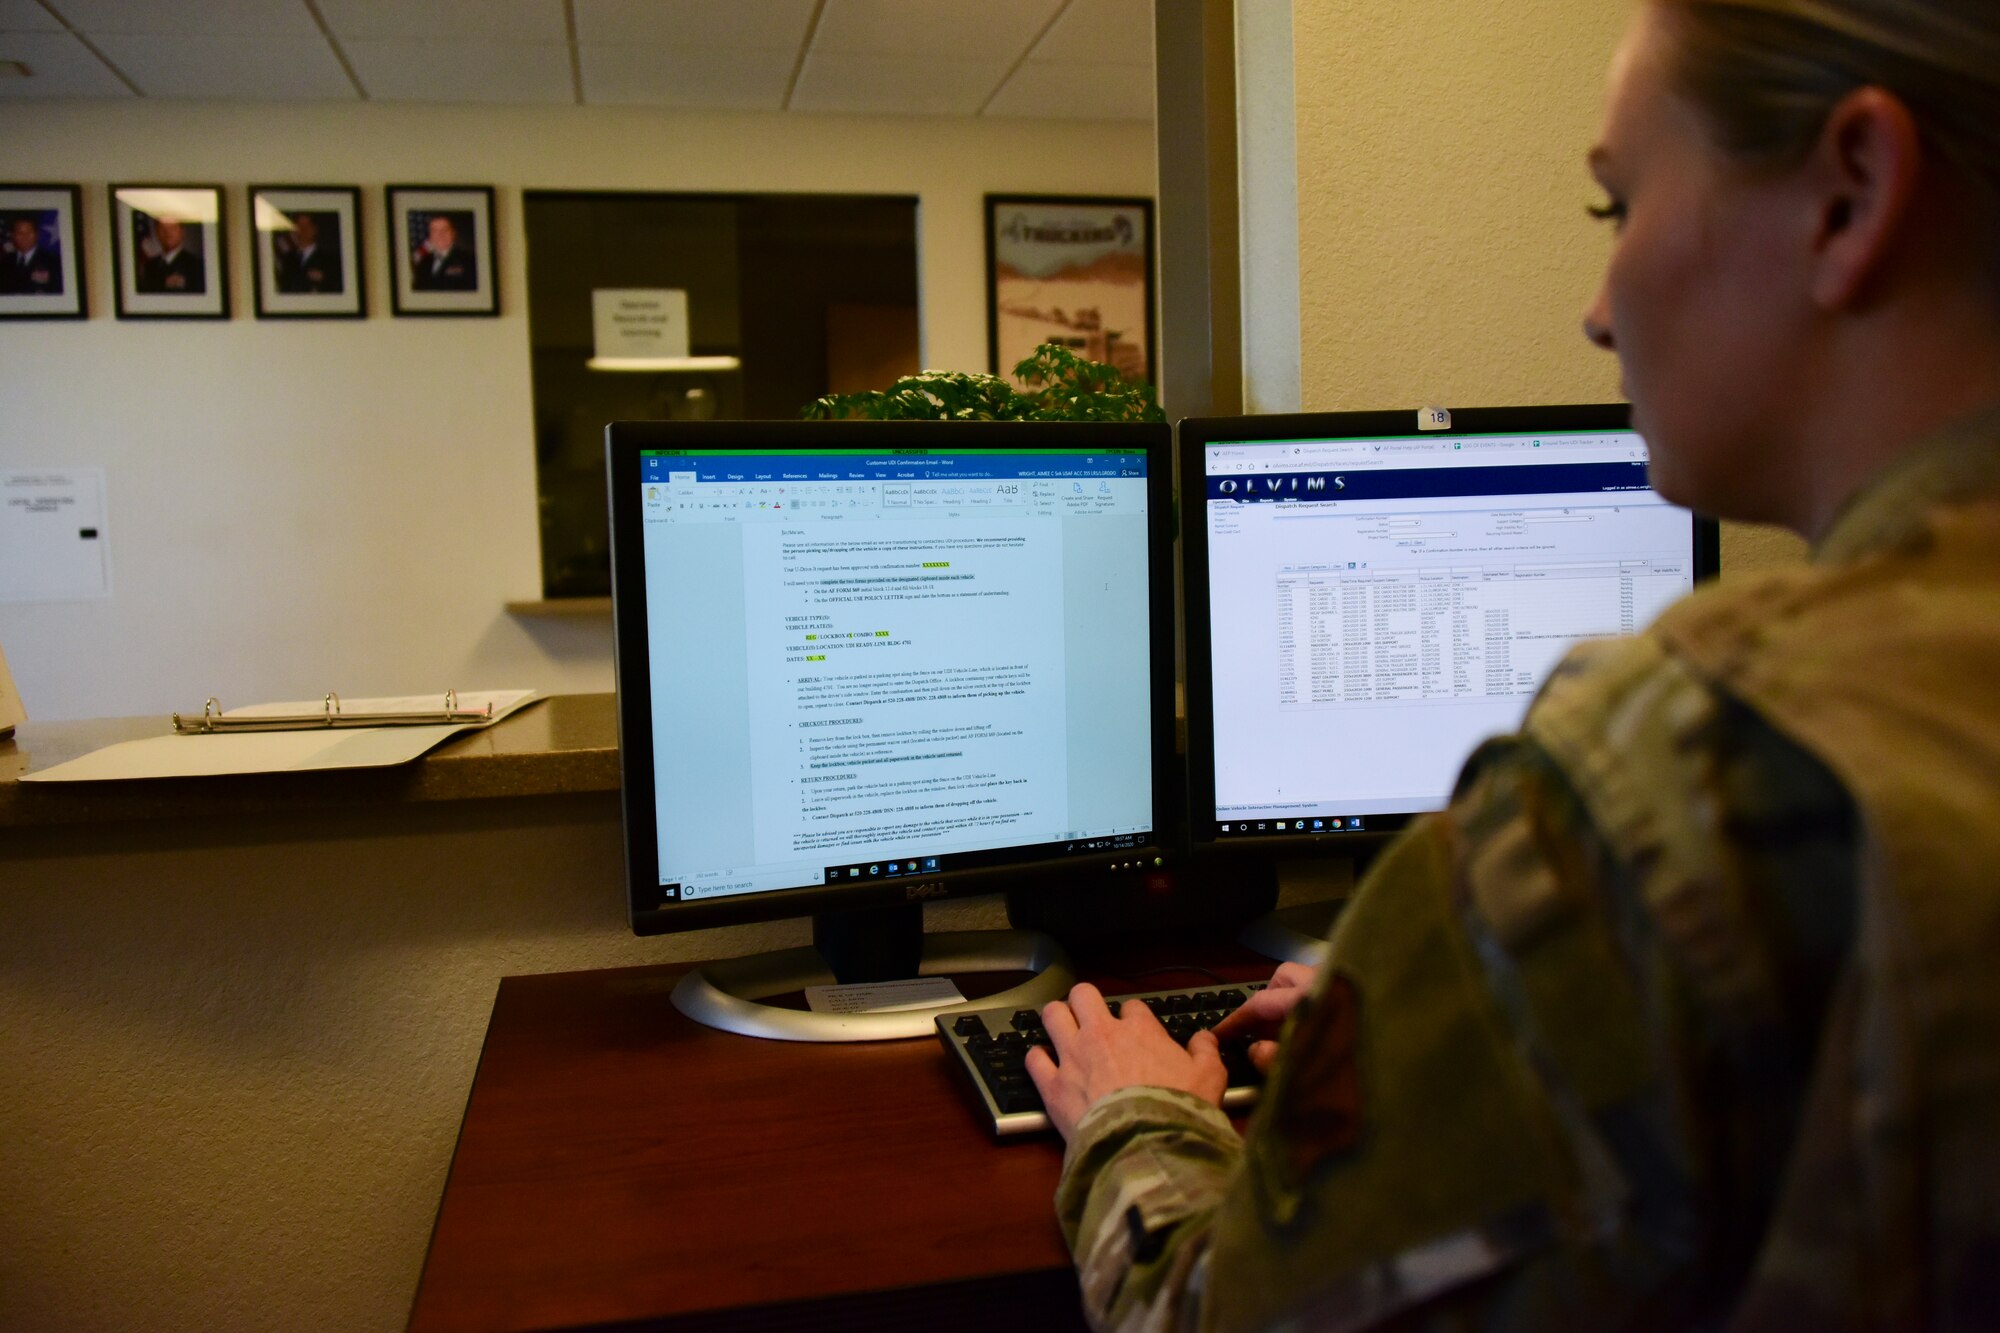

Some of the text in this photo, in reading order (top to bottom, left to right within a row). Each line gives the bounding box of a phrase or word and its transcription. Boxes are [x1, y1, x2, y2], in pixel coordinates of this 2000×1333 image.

[1431, 413, 1445, 423] 18
[698, 886, 712, 894] Type
[906, 883, 948, 899] DELL
